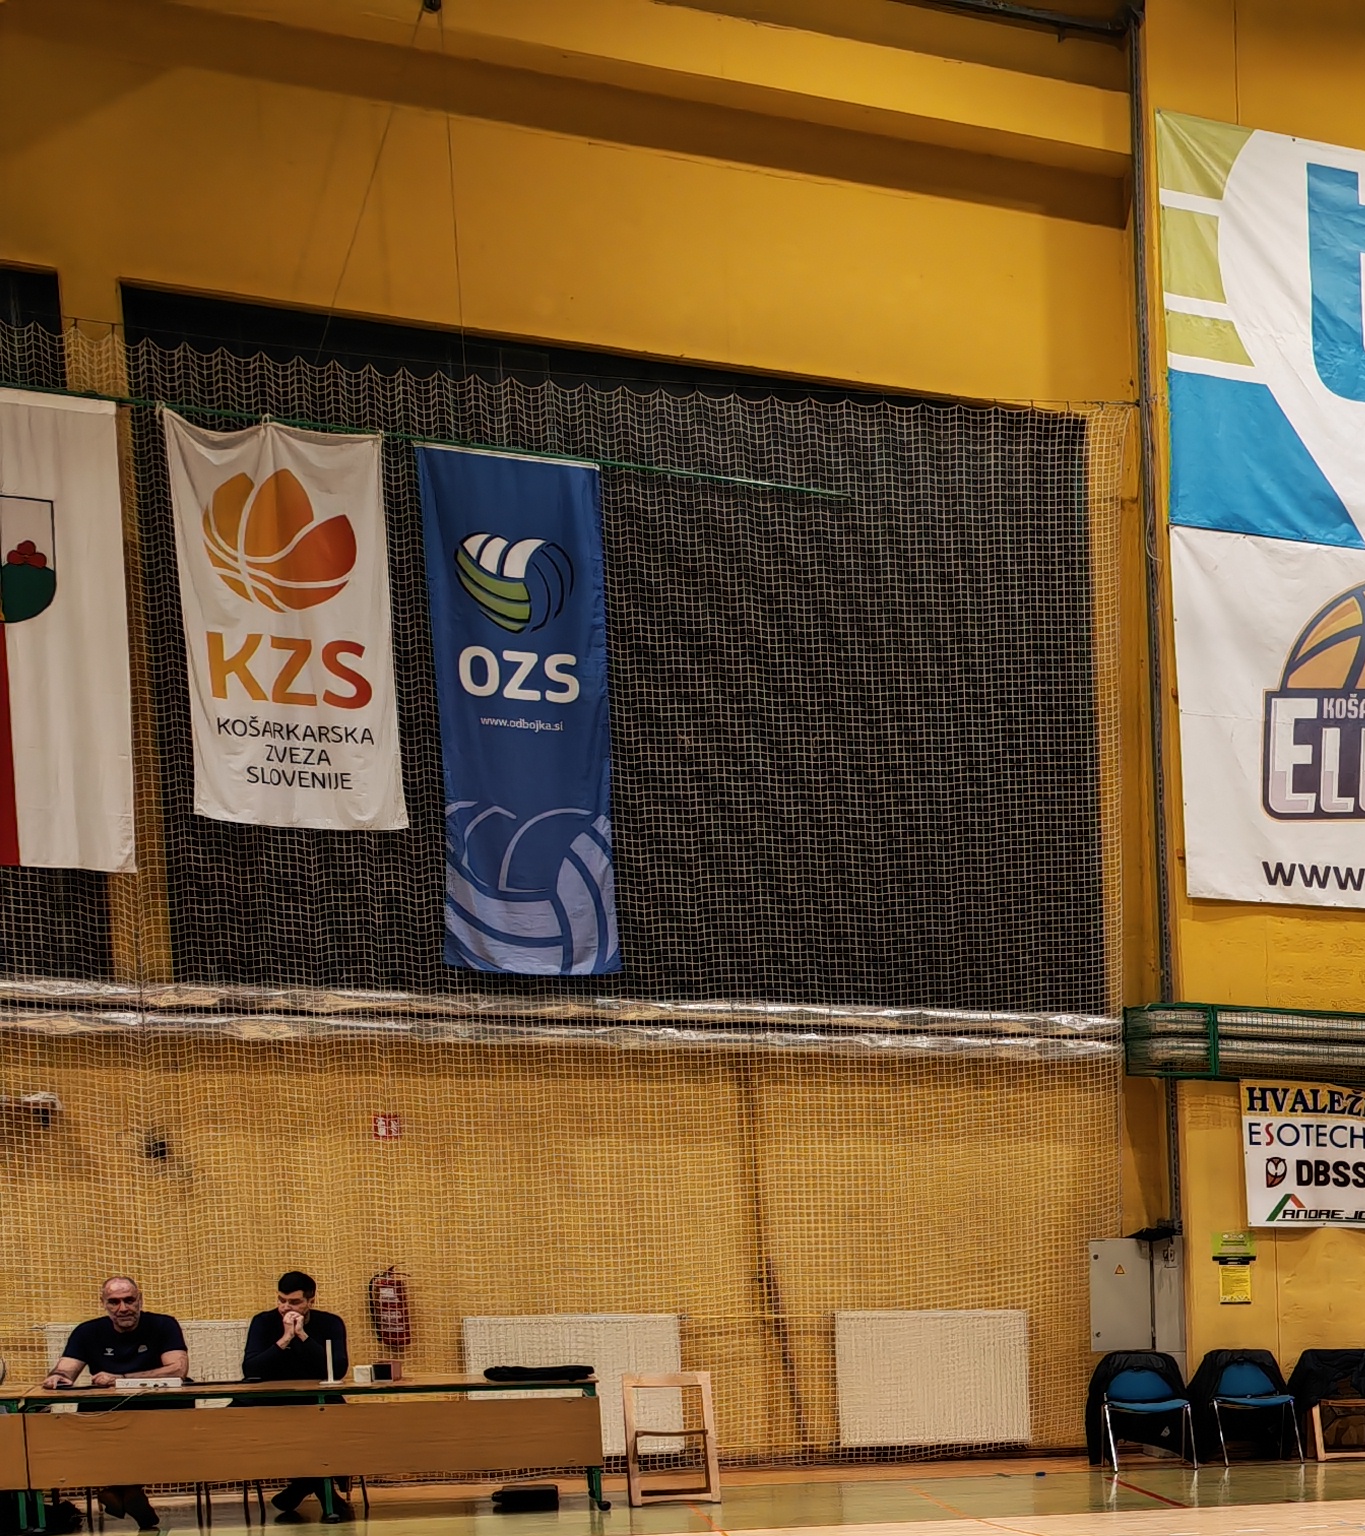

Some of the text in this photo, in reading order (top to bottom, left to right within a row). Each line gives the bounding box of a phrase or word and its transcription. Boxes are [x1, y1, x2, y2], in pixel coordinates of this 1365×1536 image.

[206, 631, 373, 709] KZS
[458, 646, 580, 703] OZS
[217, 716, 374, 745] KOŠARKARSKA
[480, 716, 564, 733] www.odbojka.si
[266, 745, 331, 767] ZVEZA
[246, 767, 353, 790] SLOVENIJE
